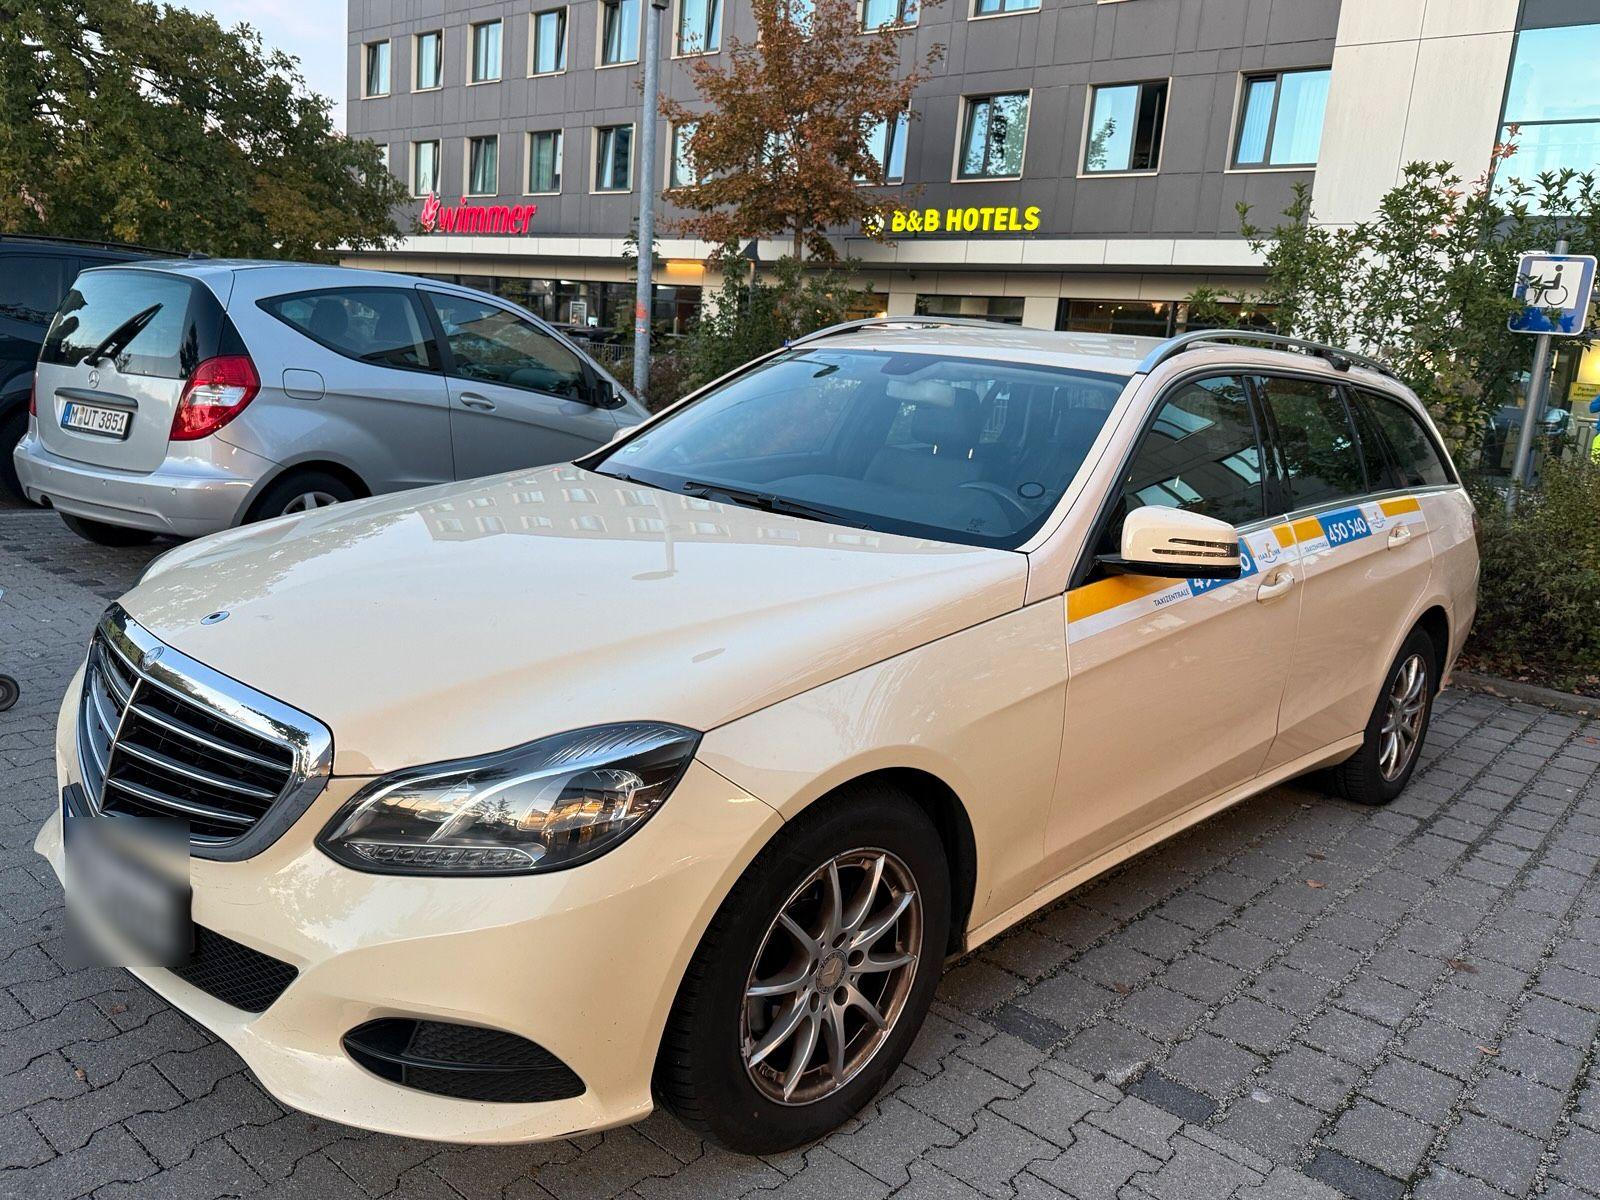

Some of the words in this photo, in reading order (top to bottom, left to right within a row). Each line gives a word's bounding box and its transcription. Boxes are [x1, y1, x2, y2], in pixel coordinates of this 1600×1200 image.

[439, 195, 537, 233] wimmer
[891, 208, 941, 232] B&B
[946, 206, 1041, 231] HOTELS
[83, 409, 98, 426] UT
[99, 411, 125, 432] 3851
[1328, 522, 1349, 543] 450
[1349, 517, 1367, 537] 540
[1153, 588, 1190, 606] TAXIZENTRALE
